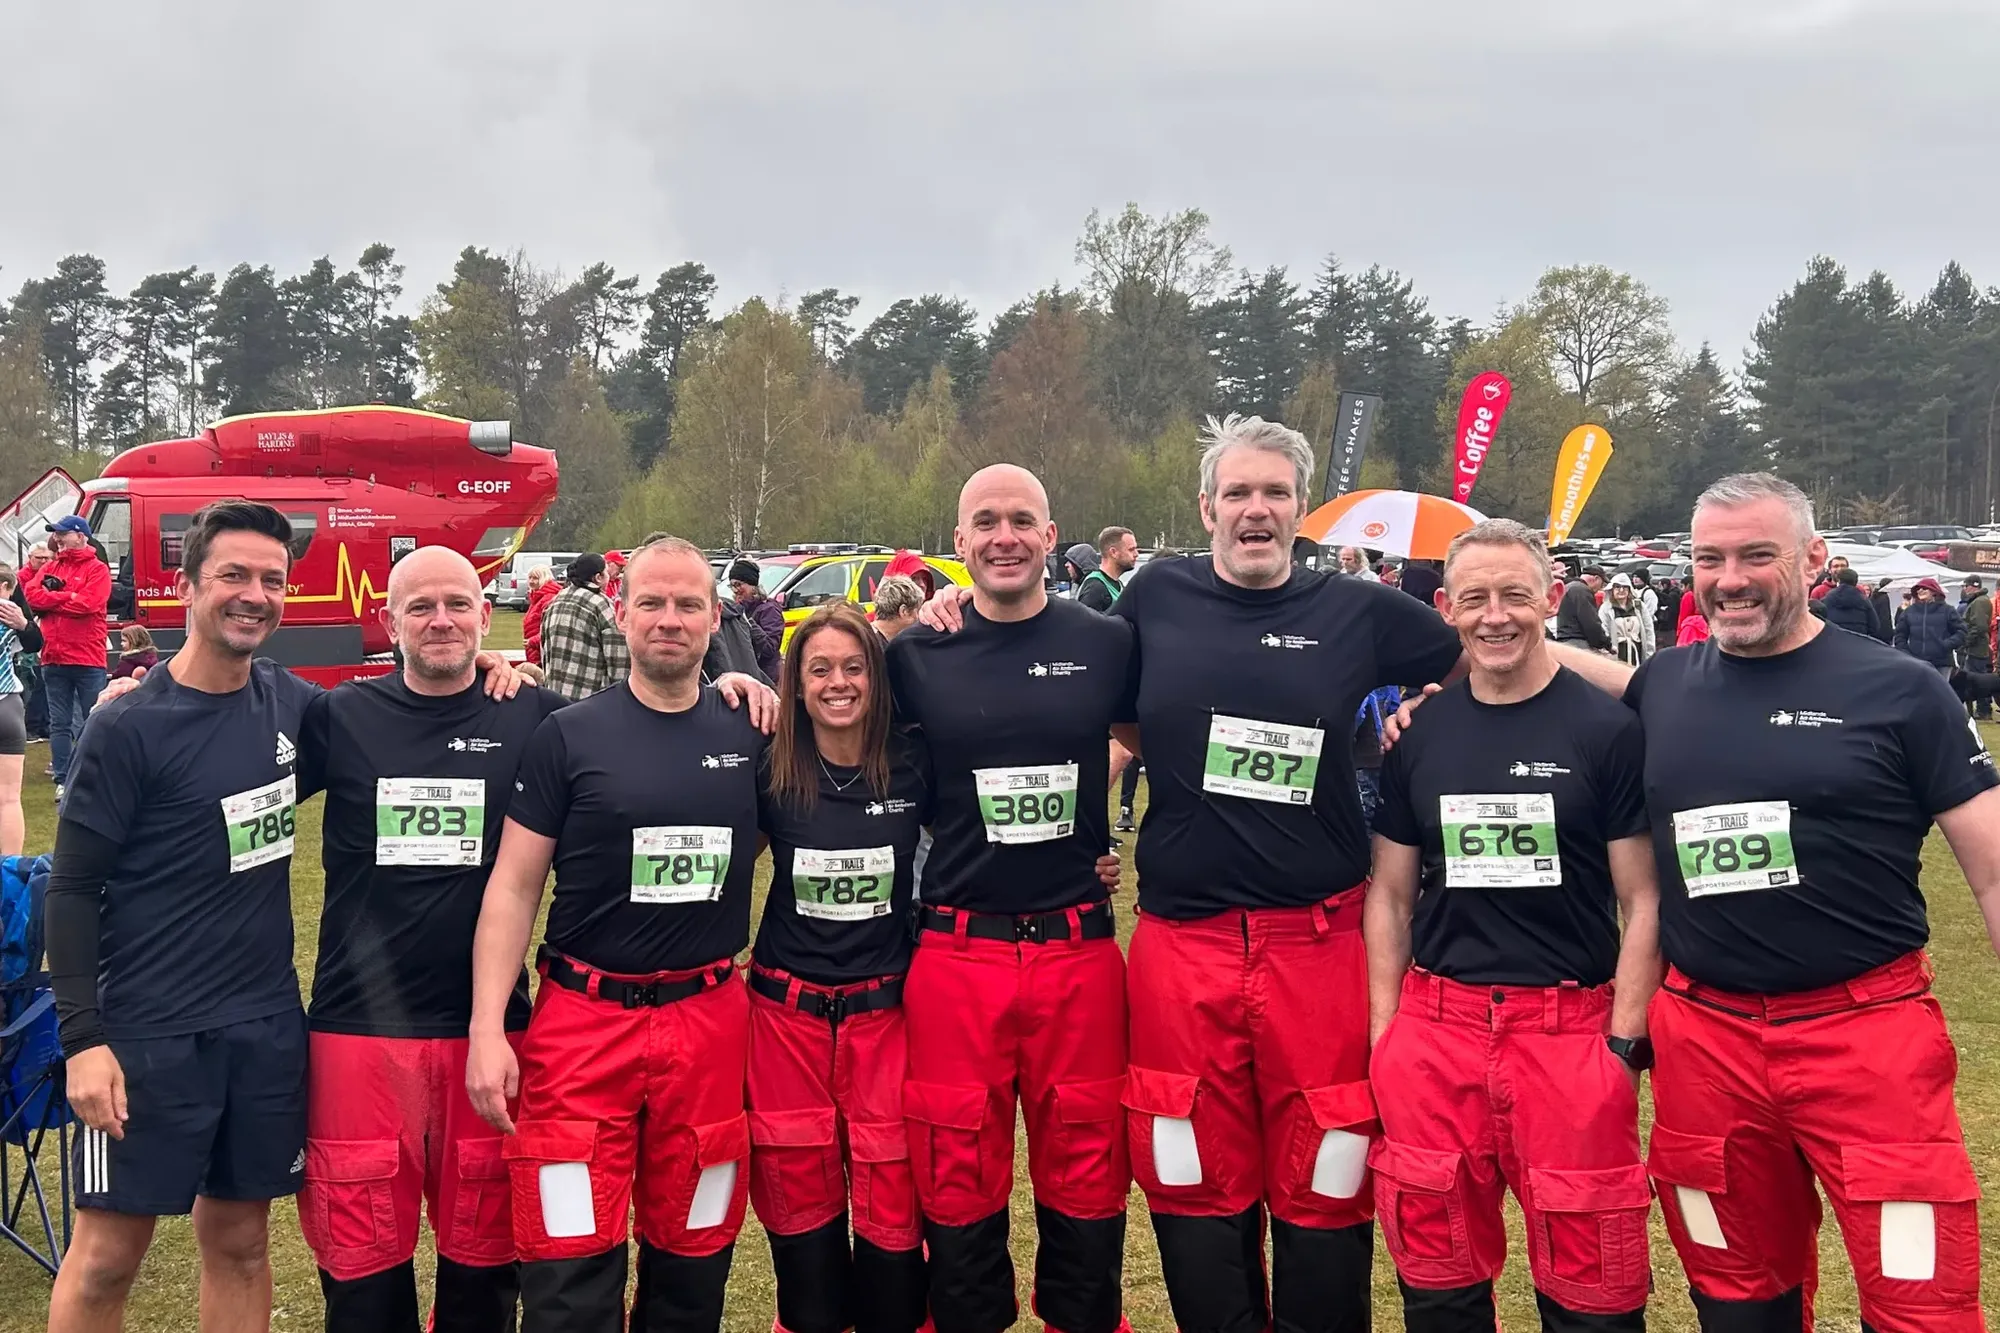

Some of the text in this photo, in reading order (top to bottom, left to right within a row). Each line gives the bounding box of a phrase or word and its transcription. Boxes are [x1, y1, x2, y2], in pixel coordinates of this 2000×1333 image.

[258, 431, 295, 441] BAYLIS &
[1345, 399, 1364, 454] SHAKES
[258, 440, 295, 448] HARDING
[1459, 406, 1494, 475] Coffee
[458, 480, 511, 494] G-EOFF
[1555, 452, 1591, 531] Smoothies
[1264, 732, 1289, 746] TRAILS
[1225, 745, 1303, 785] 787
[1025, 775, 1049, 786] TRAILS
[265, 791, 282, 806] TRAILS
[427, 788, 452, 799] TRAILS
[991, 792, 1064, 825] 380
[1495, 805, 1518, 816] TRAILS
[240, 805, 295, 850] 786
[392, 805, 467, 836] 783
[1719, 815, 1749, 828] TRAILS
[681, 836, 704, 846] TRAILS
[1459, 823, 1539, 856] 676
[840, 858, 865, 869] TRAILS
[1688, 834, 1772, 875] 789
[647, 854, 719, 885] 784
[808, 875, 879, 904] 782
